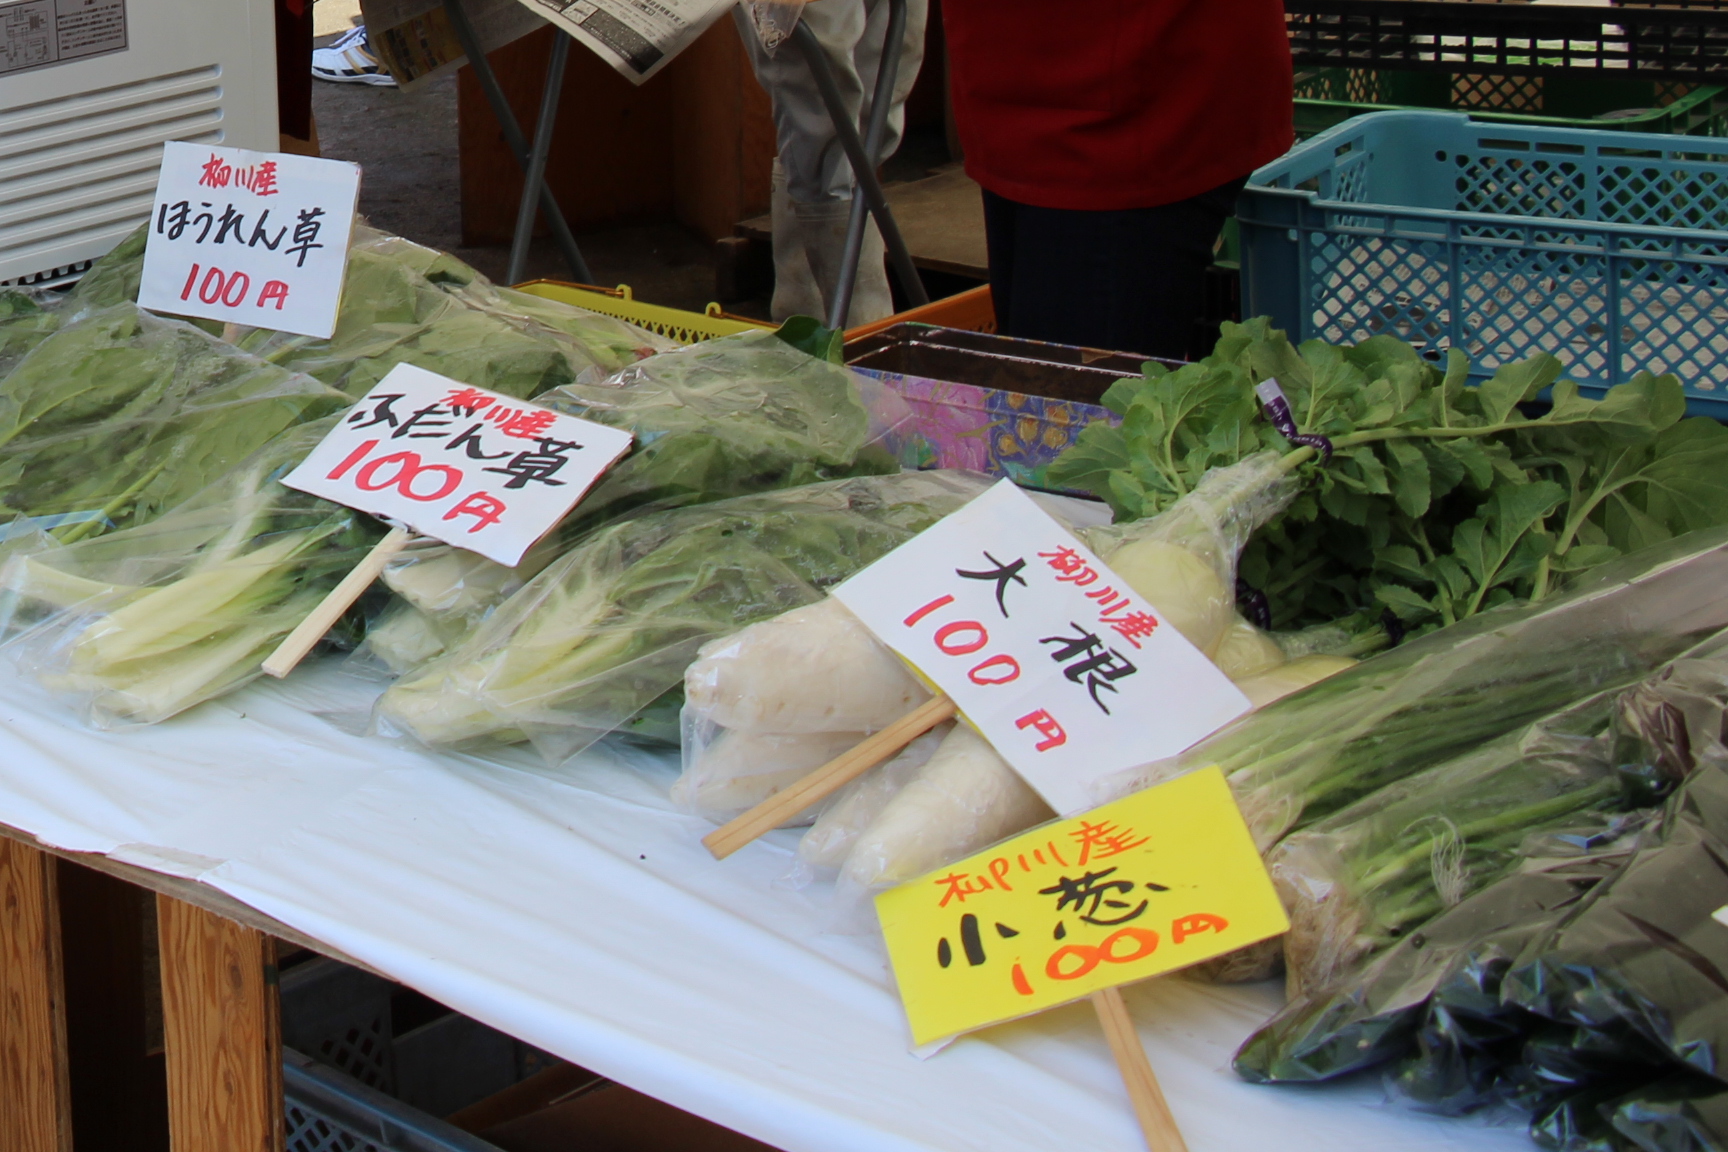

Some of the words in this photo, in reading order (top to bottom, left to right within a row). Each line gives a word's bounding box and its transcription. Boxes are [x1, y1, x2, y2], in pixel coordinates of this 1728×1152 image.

[198, 150, 280, 198] 柳川産
[156, 199, 327, 268] ほうれん草
[178, 262, 290, 312] 100円
[346, 392, 585, 490] ふだん草
[438, 386, 560, 441] 柳川産
[325, 438, 511, 535] 100円
[954, 549, 1139, 716] 大根
[1037, 542, 1161, 650] 柳川産
[901, 592, 1069, 754] 100円
[1010, 910, 1230, 997] 100円
